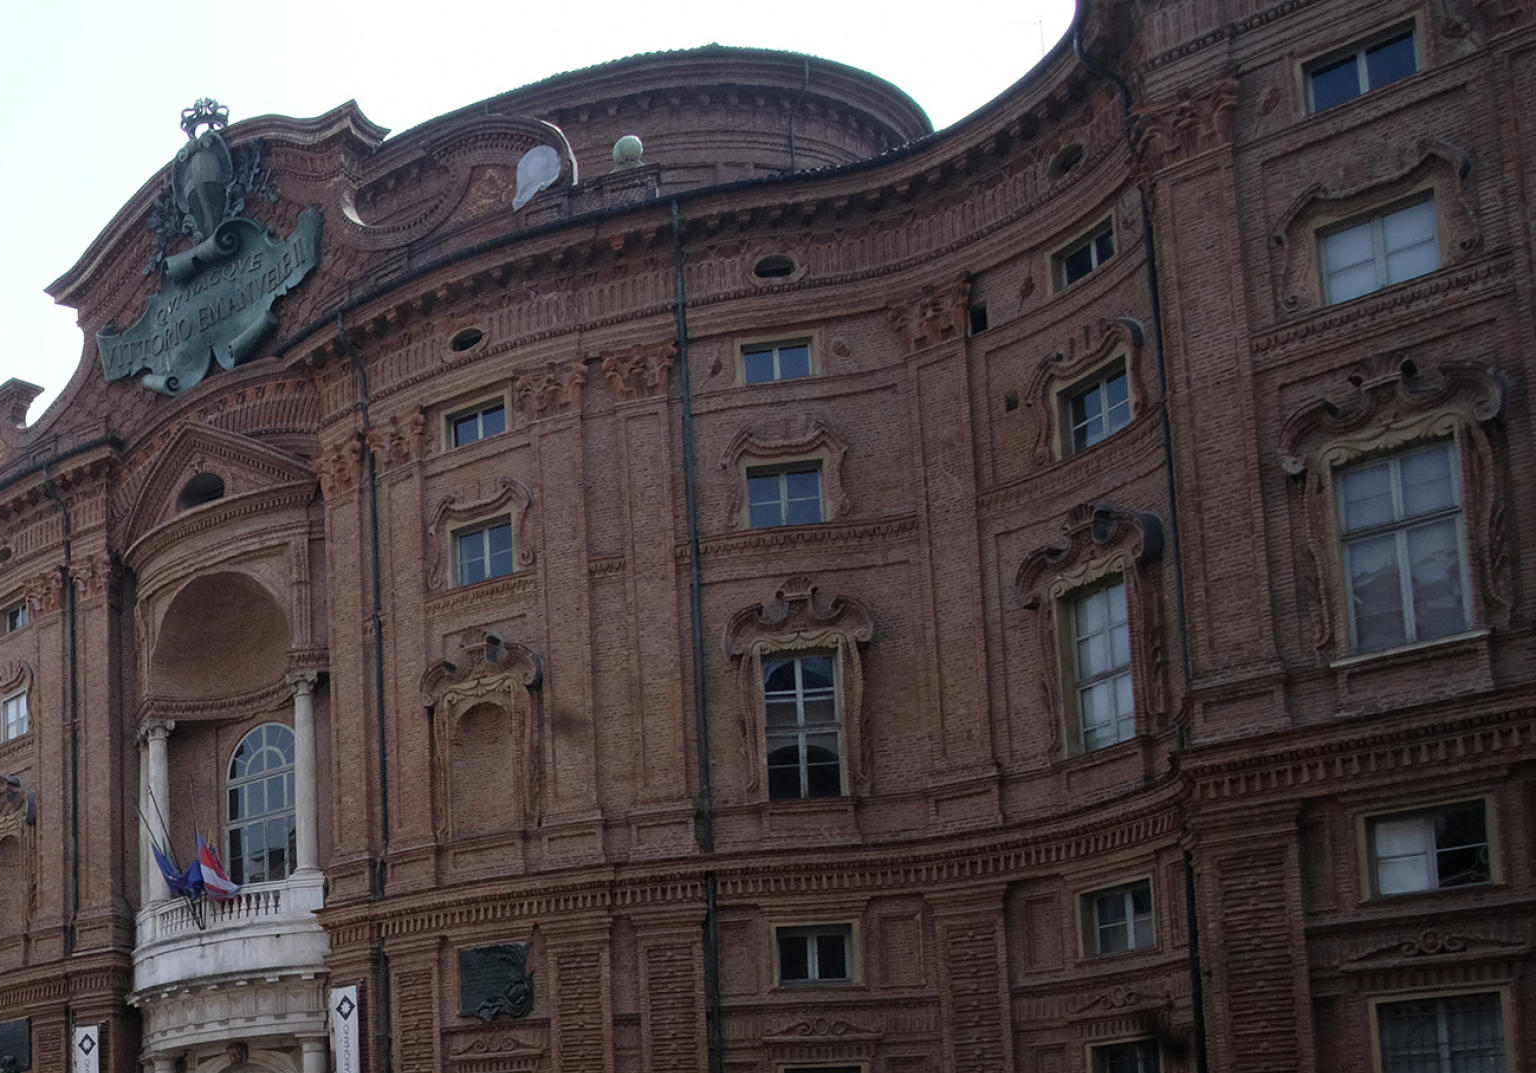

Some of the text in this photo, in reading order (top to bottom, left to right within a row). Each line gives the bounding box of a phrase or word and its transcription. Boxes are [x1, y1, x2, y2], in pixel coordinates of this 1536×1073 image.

[103, 238, 308, 370] VITTORIO EMANVELE II
[185, 252, 264, 300] NACQVE
